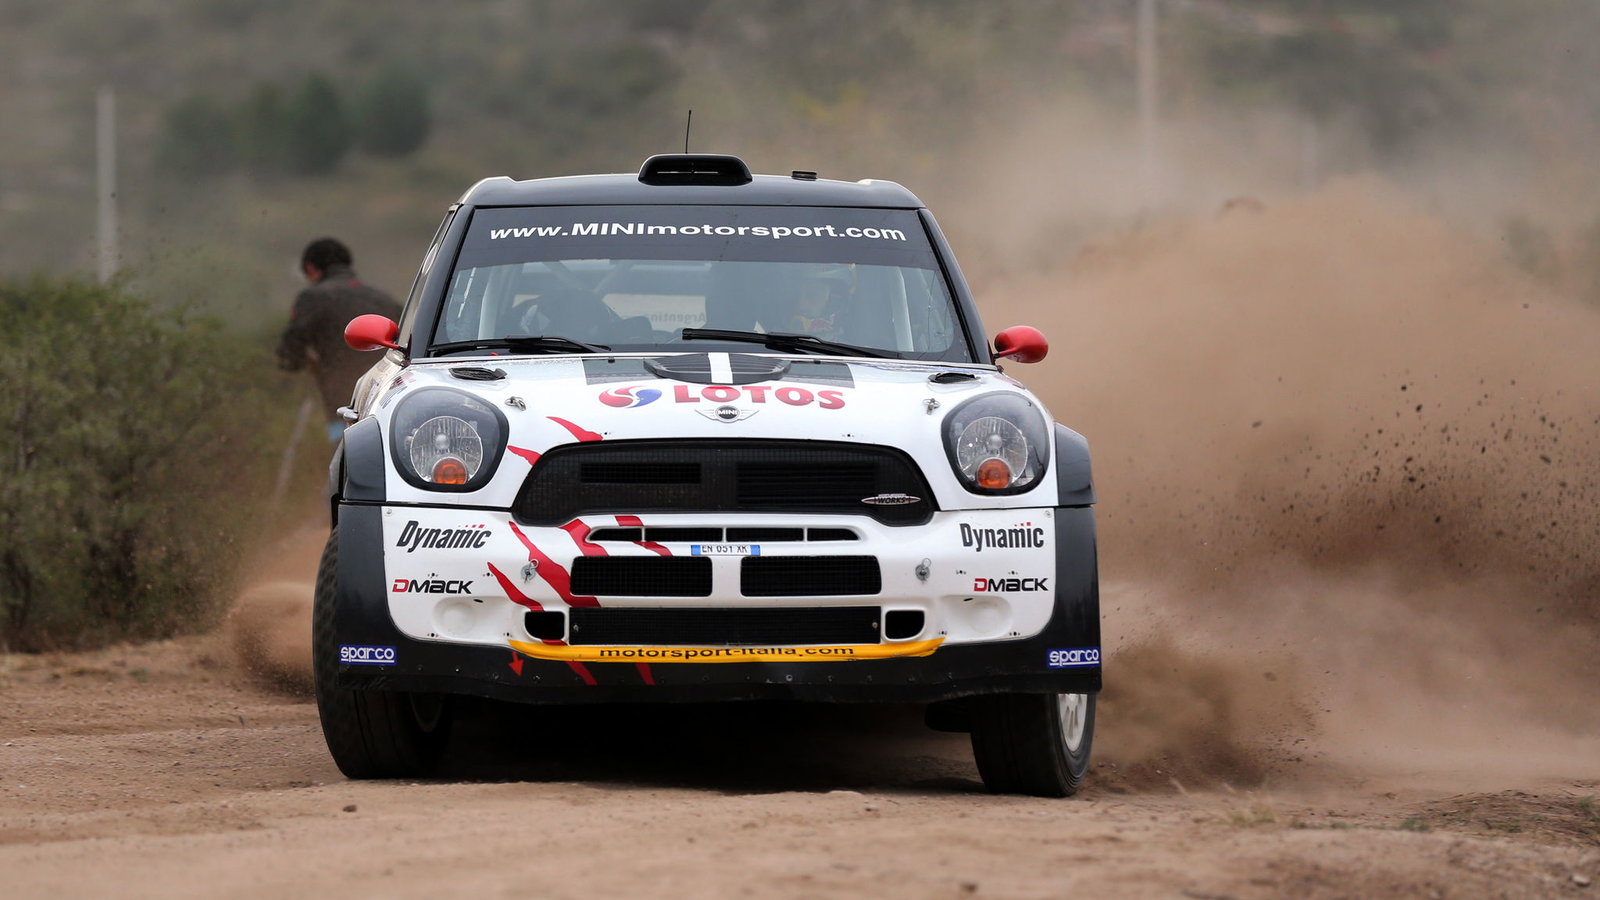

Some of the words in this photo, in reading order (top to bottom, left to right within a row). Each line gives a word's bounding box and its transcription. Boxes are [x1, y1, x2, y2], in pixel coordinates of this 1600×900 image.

[490, 223, 907, 241] www.MINImotorsport.com
[673, 385, 846, 410] LOTOS
[717, 408, 738, 416] MINI
[396, 520, 492, 553] Dynamic
[960, 522, 1044, 552] Dynamic
[702, 545, 713, 553] EN
[392, 579, 473, 594] DMACK
[974, 578, 1048, 592] DMACK
[340, 646, 395, 662] sparco
[1049, 649, 1099, 665] sparco
